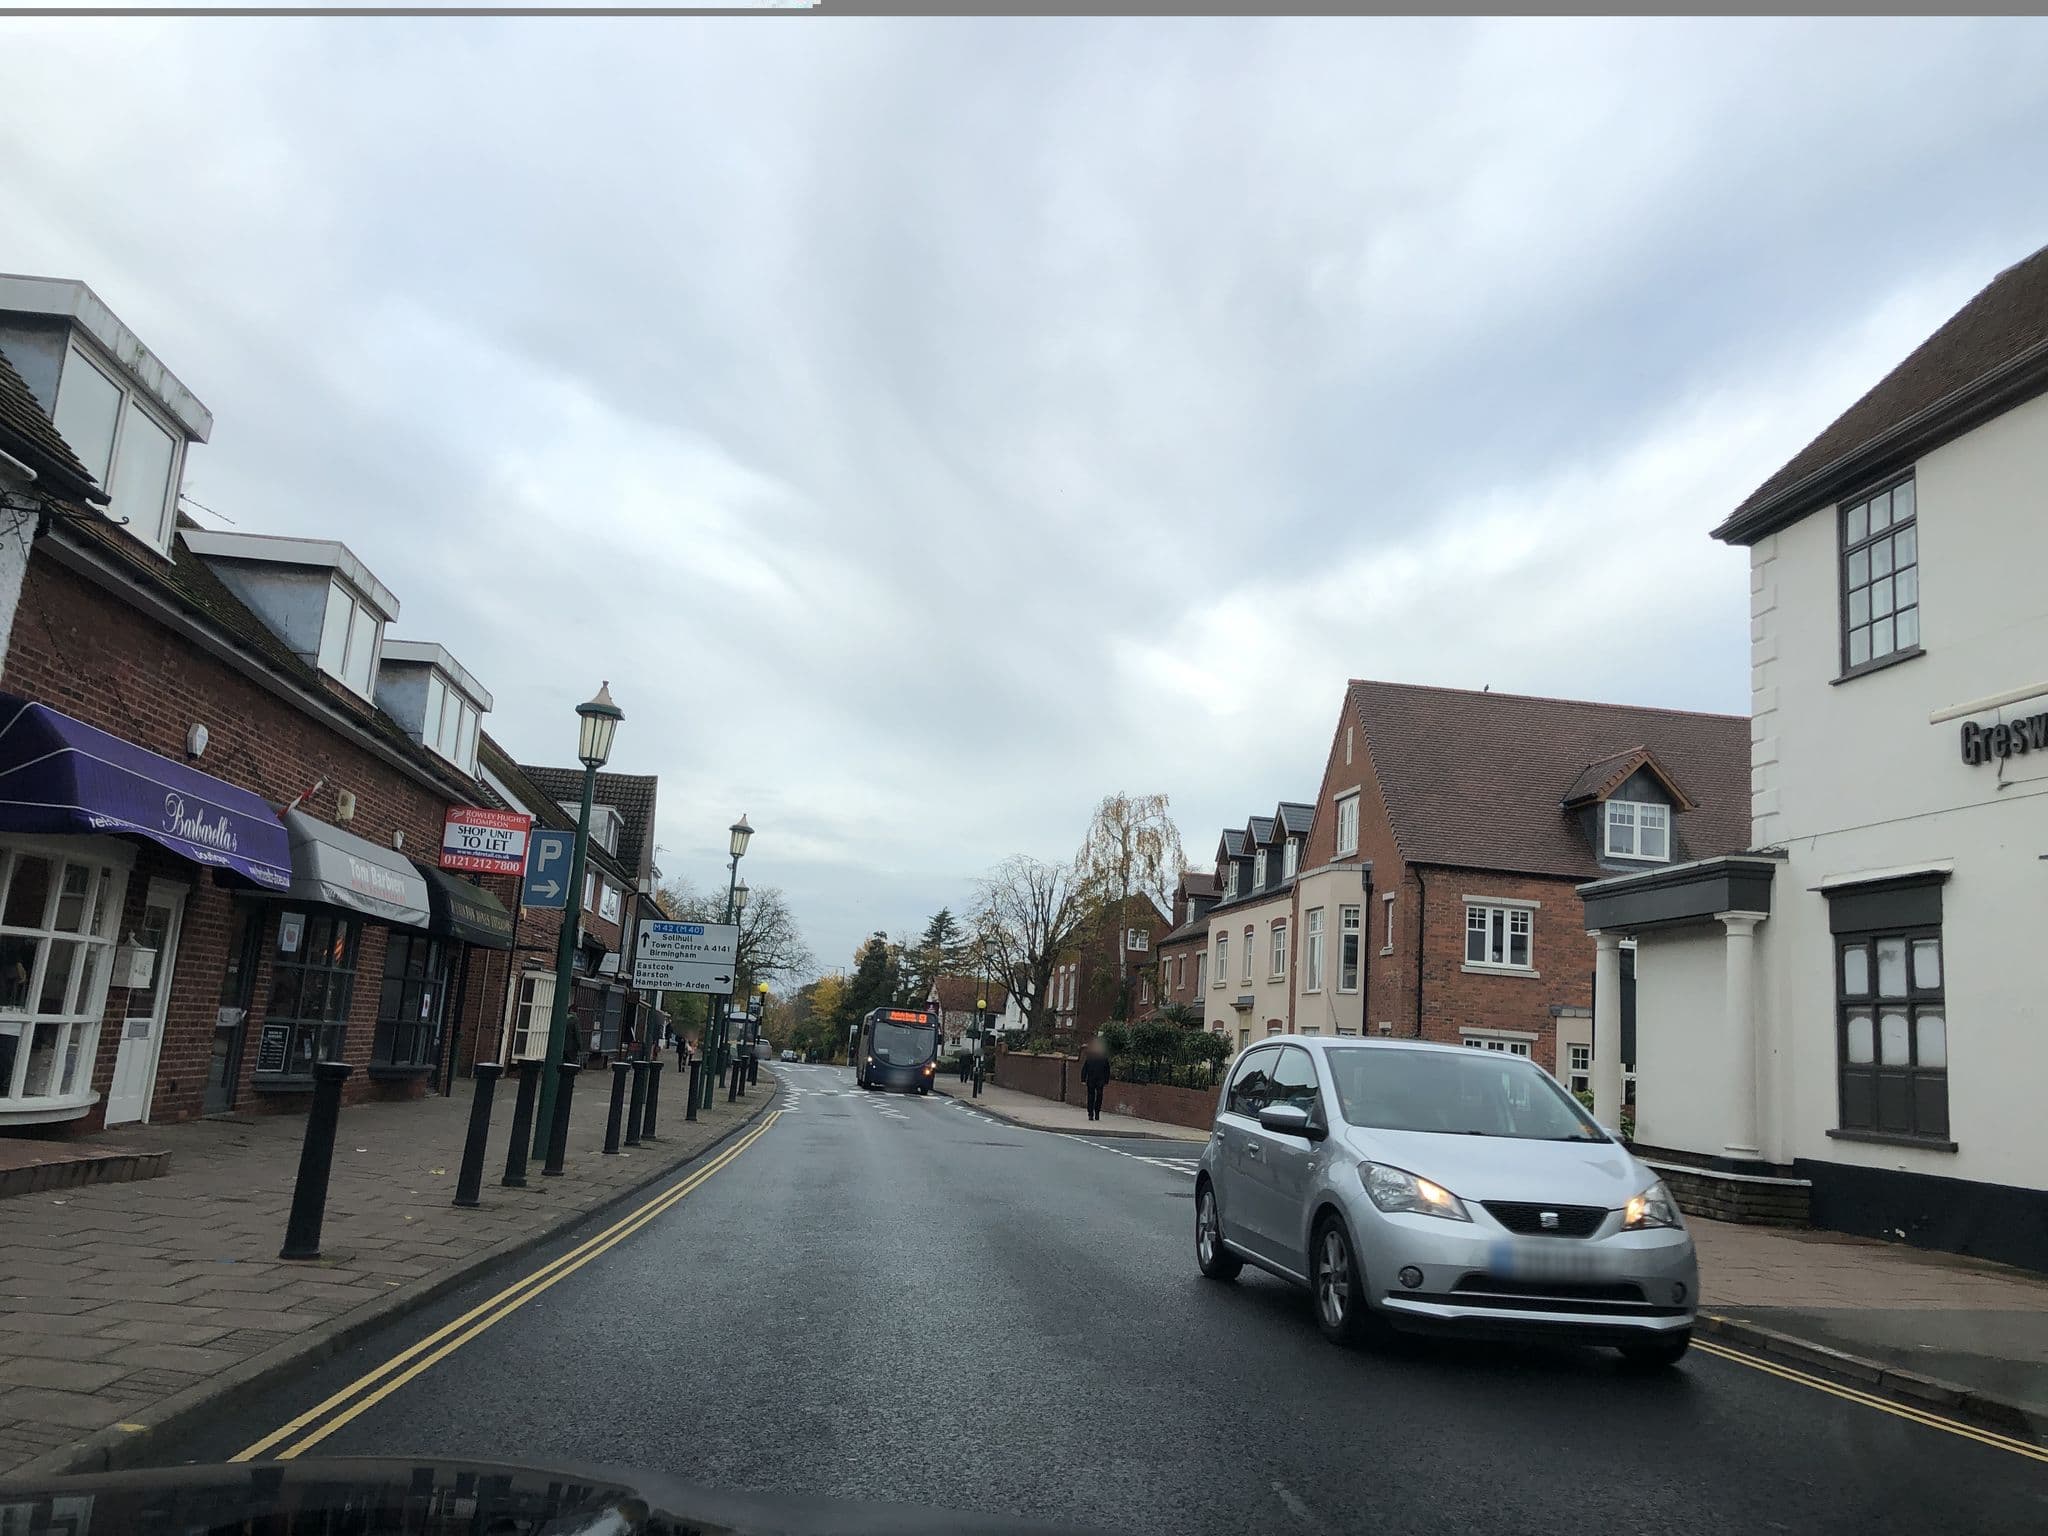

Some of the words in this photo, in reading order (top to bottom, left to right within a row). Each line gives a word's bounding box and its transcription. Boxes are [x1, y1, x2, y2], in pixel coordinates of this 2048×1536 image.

[465, 809, 496, 820] ROWLEY
[497, 814, 527, 824] HUGHES
[163, 793, 238, 851] Barbarella's
[466, 817, 509, 828] THOMPSON
[458, 825, 486, 836] SHOP
[490, 830, 514, 840] UNIT
[462, 835, 481, 848] TO
[486, 838, 509, 852] LET
[538, 839, 562, 872] P
[444, 854, 469, 866] 0121
[472, 858, 492, 869] 212
[494, 860, 520, 872] 7800
[688, 926, 704, 934] 40)
[662, 934, 693, 942] Solihull
[674, 943, 701, 951] Centre
[650, 950, 696, 959] Birmingham
[637, 962, 674, 970] Eastcote
[636, 970, 669, 978] Barston
[635, 979, 710, 989] Hampton-in-Arden
